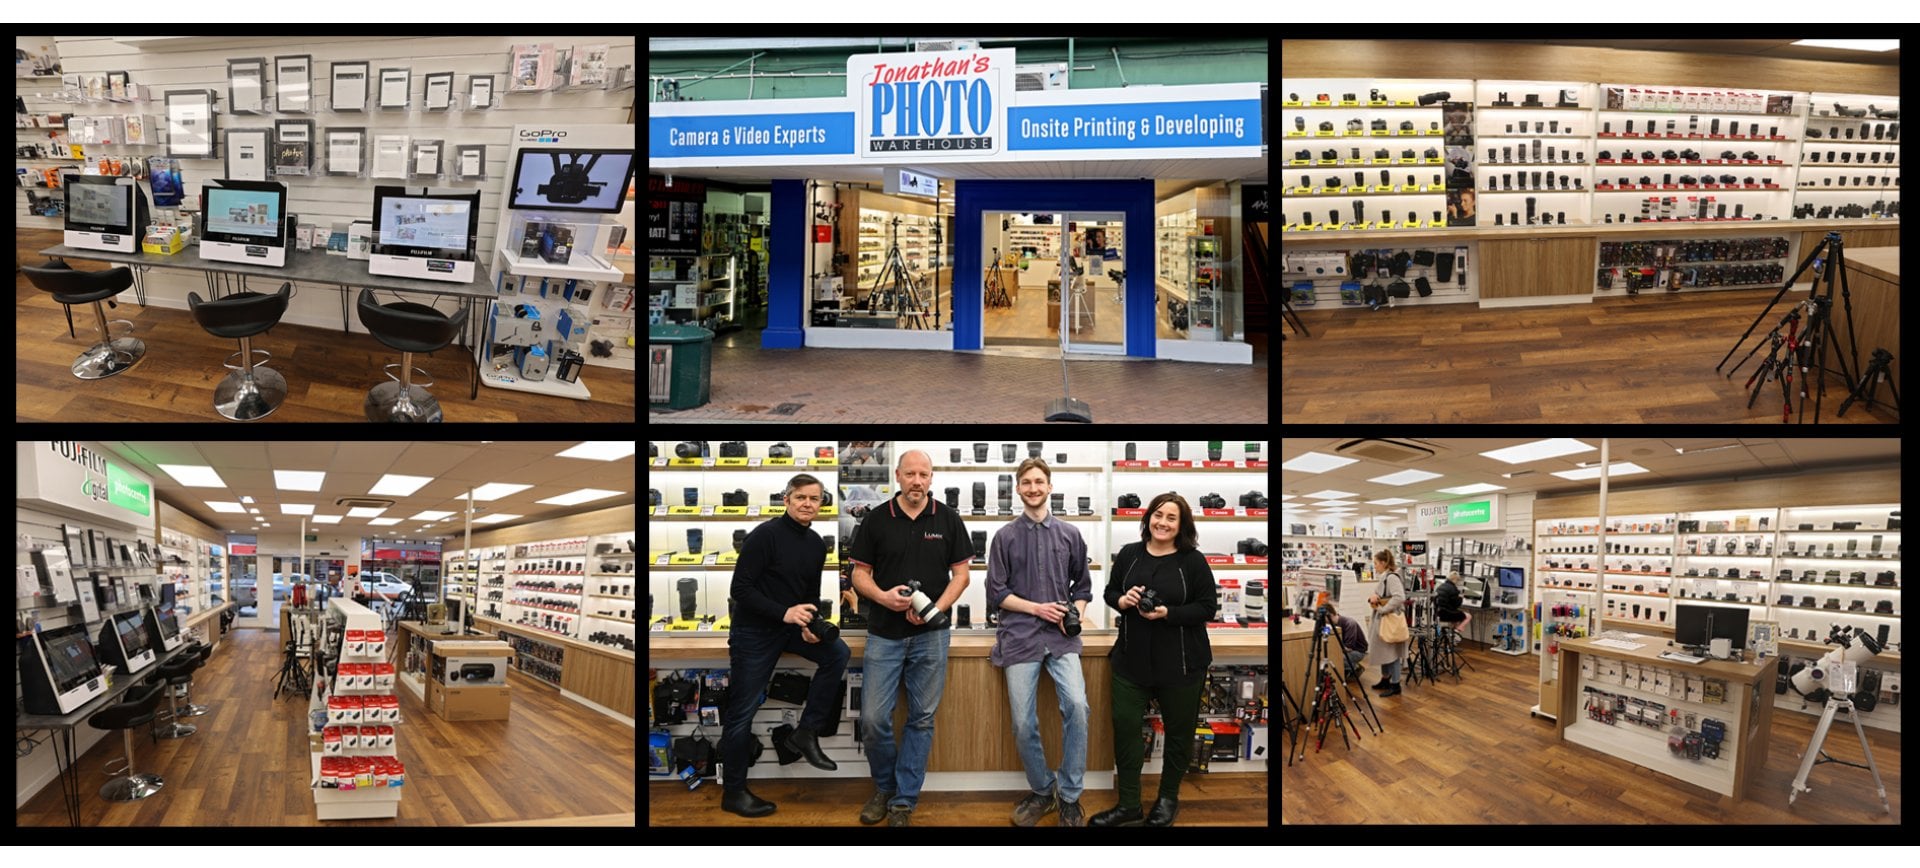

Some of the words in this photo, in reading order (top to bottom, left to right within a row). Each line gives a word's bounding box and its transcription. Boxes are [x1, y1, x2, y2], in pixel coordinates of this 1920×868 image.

[868, 53, 990, 86] Jonathan's
[870, 78, 992, 137] PHOTO
[519, 129, 568, 138] GoPro
[669, 127, 718, 146] Camera
[722, 128, 730, 145] &
[734, 126, 770, 145] Video
[774, 125, 826, 148] Experts
[1021, 118, 1069, 138] Onsite
[1074, 117, 1136, 141] Printing
[1141, 118, 1150, 136] &
[1155, 114, 1244, 139] Developing
[872, 139, 989, 151] WAREHOUSE
